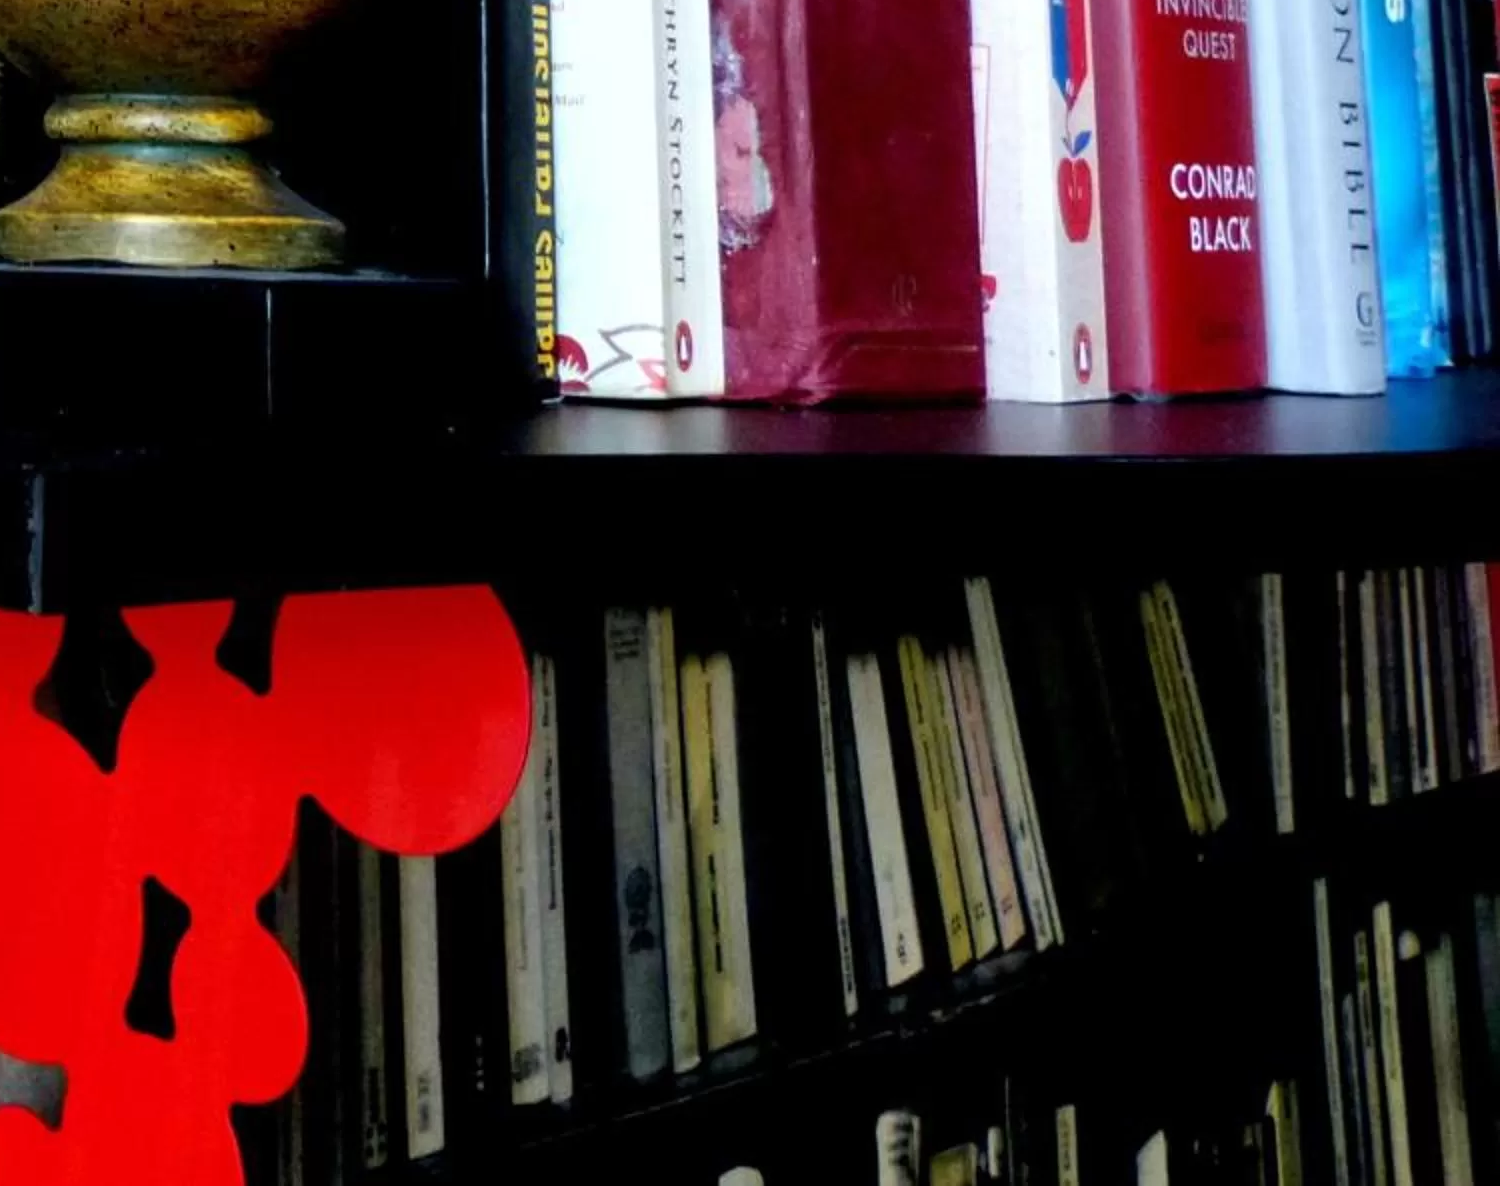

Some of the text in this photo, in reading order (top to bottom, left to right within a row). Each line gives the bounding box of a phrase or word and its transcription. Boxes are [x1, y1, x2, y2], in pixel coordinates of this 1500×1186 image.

[1182, 29, 1236, 61] QUEST
[665, 113, 691, 285] STOCKETT
[1169, 163, 1257, 201] CONRAD
[1339, 99, 1371, 264] BIBLE
[1189, 216, 1252, 252] BLACK
